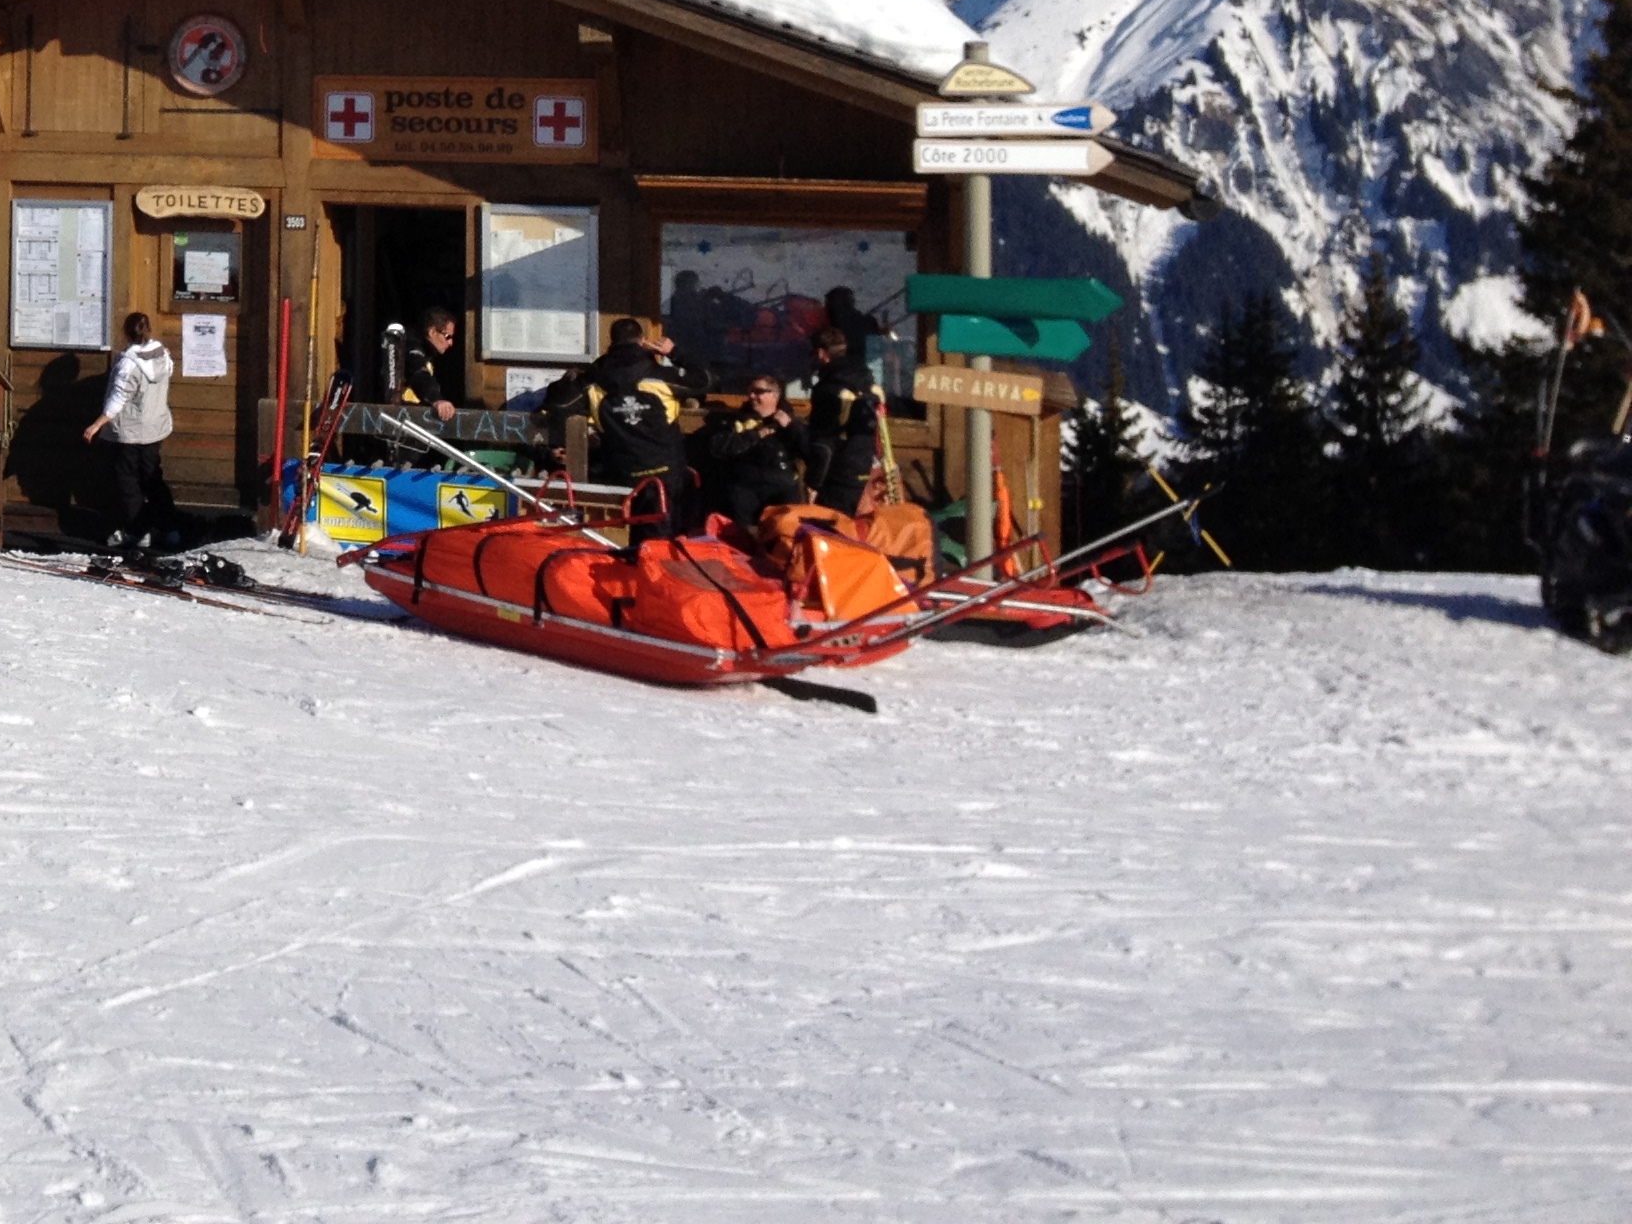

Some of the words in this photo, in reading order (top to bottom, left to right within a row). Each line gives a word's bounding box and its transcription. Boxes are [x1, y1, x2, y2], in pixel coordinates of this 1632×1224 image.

[384, 87, 473, 113] poste
[485, 87, 526, 110] de
[390, 115, 518, 135] secours
[924, 112, 939, 127] La
[942, 111, 973, 127] Petite
[977, 110, 1029, 127] Fontaine
[922, 147, 956, 164] Côte
[963, 147, 1009, 164] 2000
[153, 193, 259, 214] TOILETTES
[914, 373, 964, 394] PARC
[971, 379, 1022, 401] ARVA
[338, 405, 530, 444] YNASTAR
